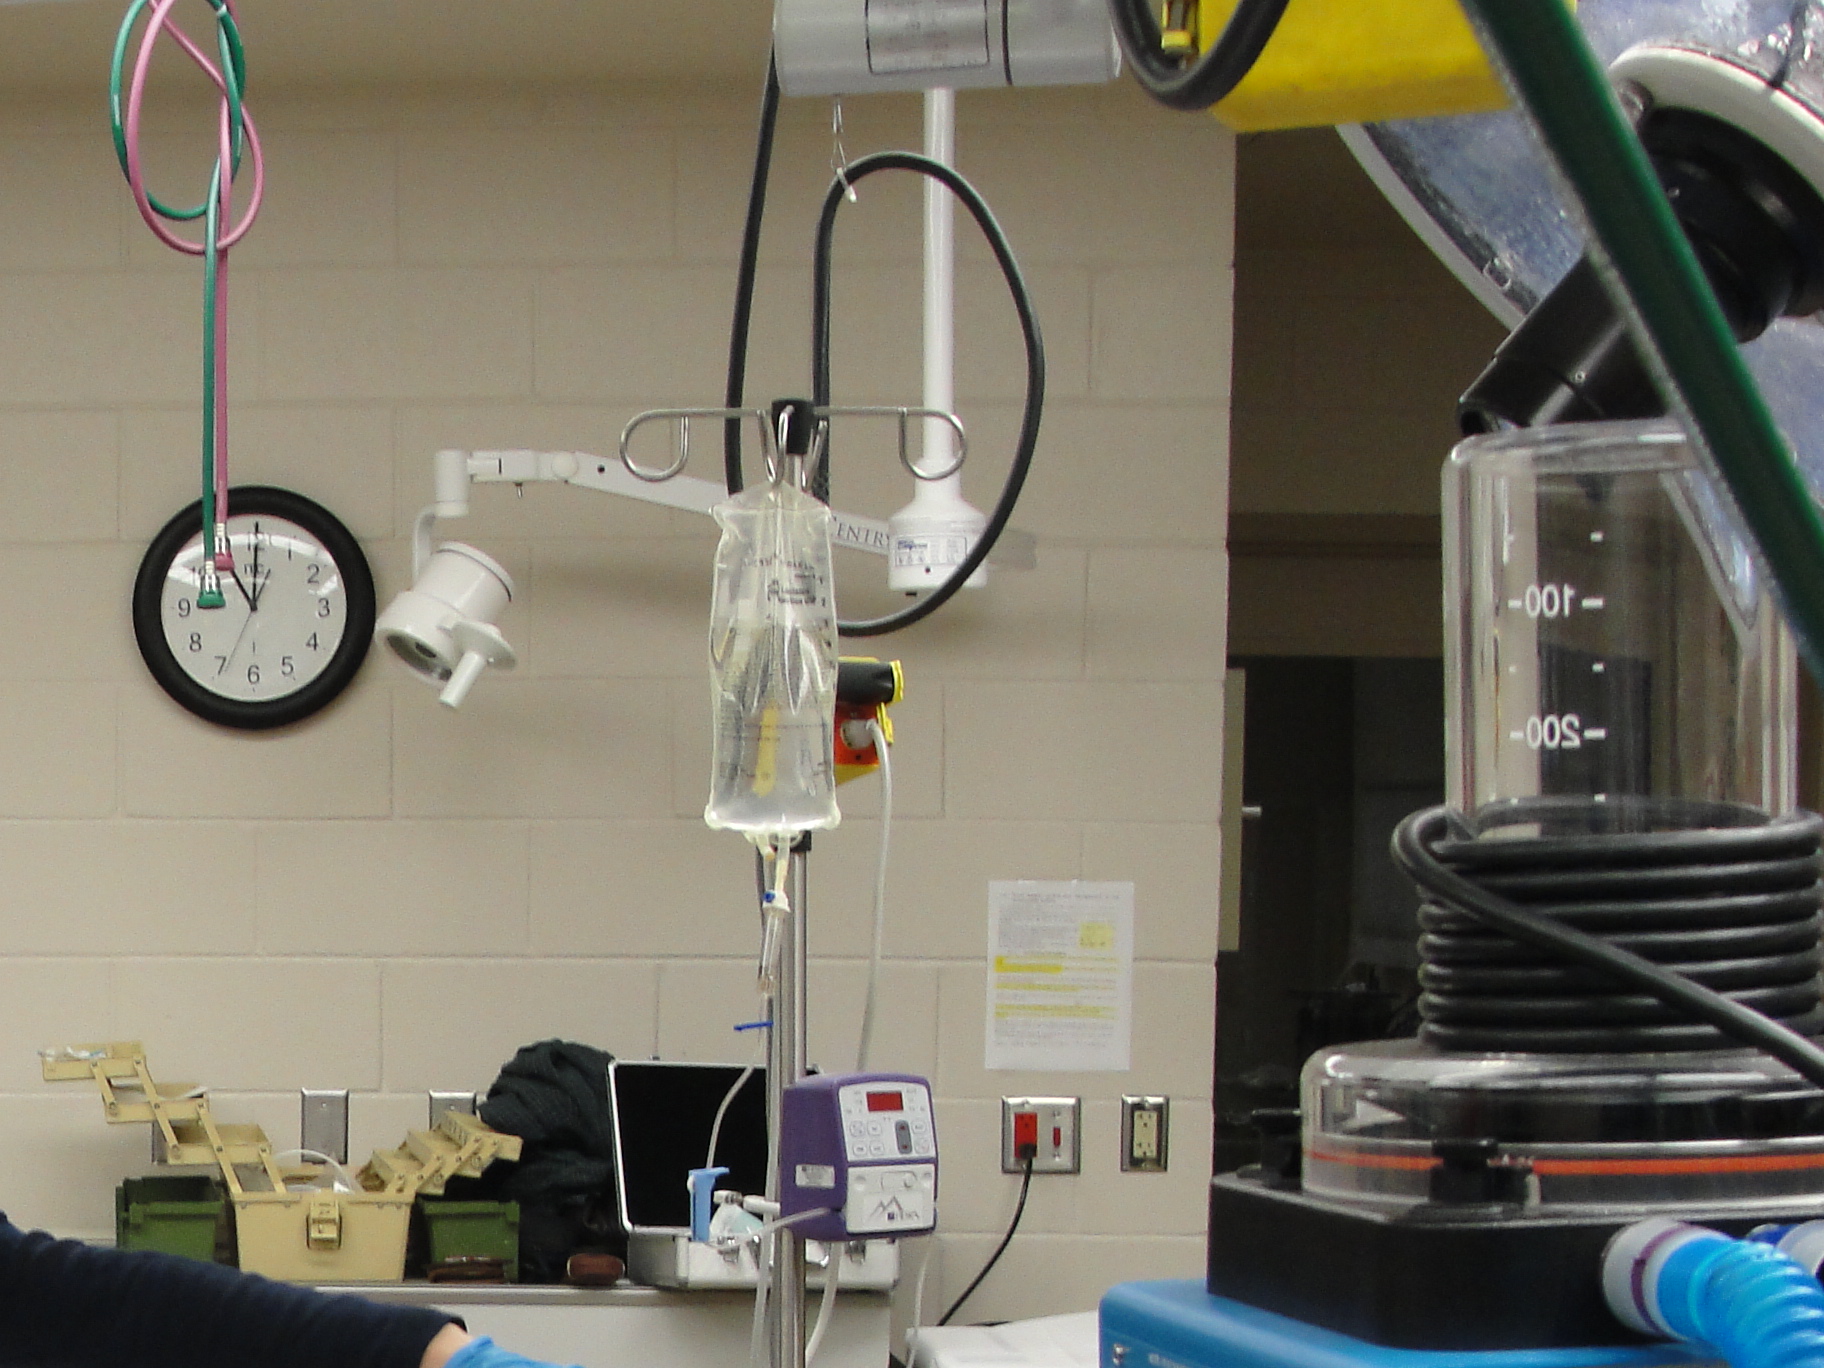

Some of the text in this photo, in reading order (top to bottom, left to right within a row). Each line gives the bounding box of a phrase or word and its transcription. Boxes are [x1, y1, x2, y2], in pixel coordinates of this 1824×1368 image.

[306, 564, 320, 584] 2
[177, 598, 192, 618] 9
[317, 598, 331, 618] 3
[188, 632, 202, 652] 8
[305, 632, 319, 651] 4
[214, 655, 227, 676] 7
[247, 665, 261, 684] 6
[281, 656, 294, 676] 5
